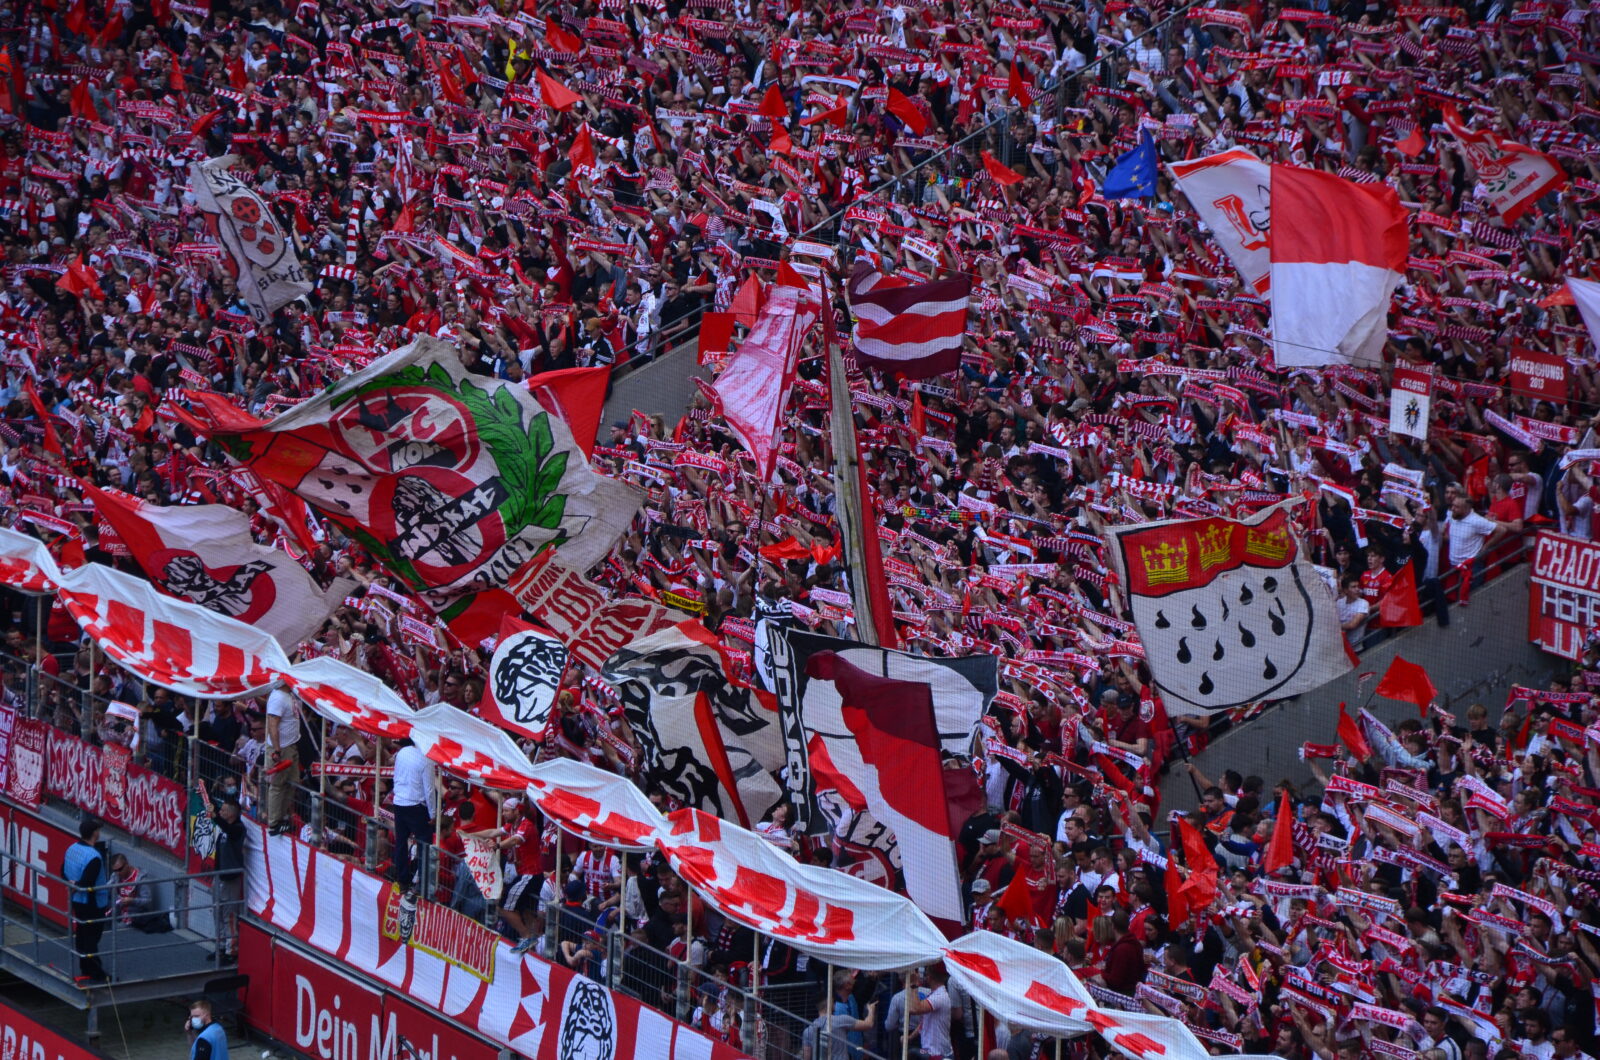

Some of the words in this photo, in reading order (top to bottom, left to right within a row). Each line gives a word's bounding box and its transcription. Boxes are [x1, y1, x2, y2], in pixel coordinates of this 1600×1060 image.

[857, 209, 866, 218] FC
[866, 211, 886, 223] KÖLN
[913, 207, 924, 216] ICH
[926, 211, 939, 220] BIN
[939, 215, 949, 223] FC
[1529, 376, 1545, 390] 2013
[689, 456, 700, 465] FC
[701, 458, 723, 470] KÖLN
[1081, 609, 1130, 632] DOUBLESIEGER
[1337, 781, 1349, 790] FC
[1349, 783, 1377, 798] KÖLN
[413, 898, 498, 977] STADIONVERBOT
[1288, 975, 1304, 990] ICH
[1306, 983, 1324, 997] BIN
[1326, 991, 1341, 1005] FC
[296, 974, 358, 1060] Dein
[1355, 1006, 1369, 1018] FC
[1371, 1007, 1406, 1027] KÖLN
